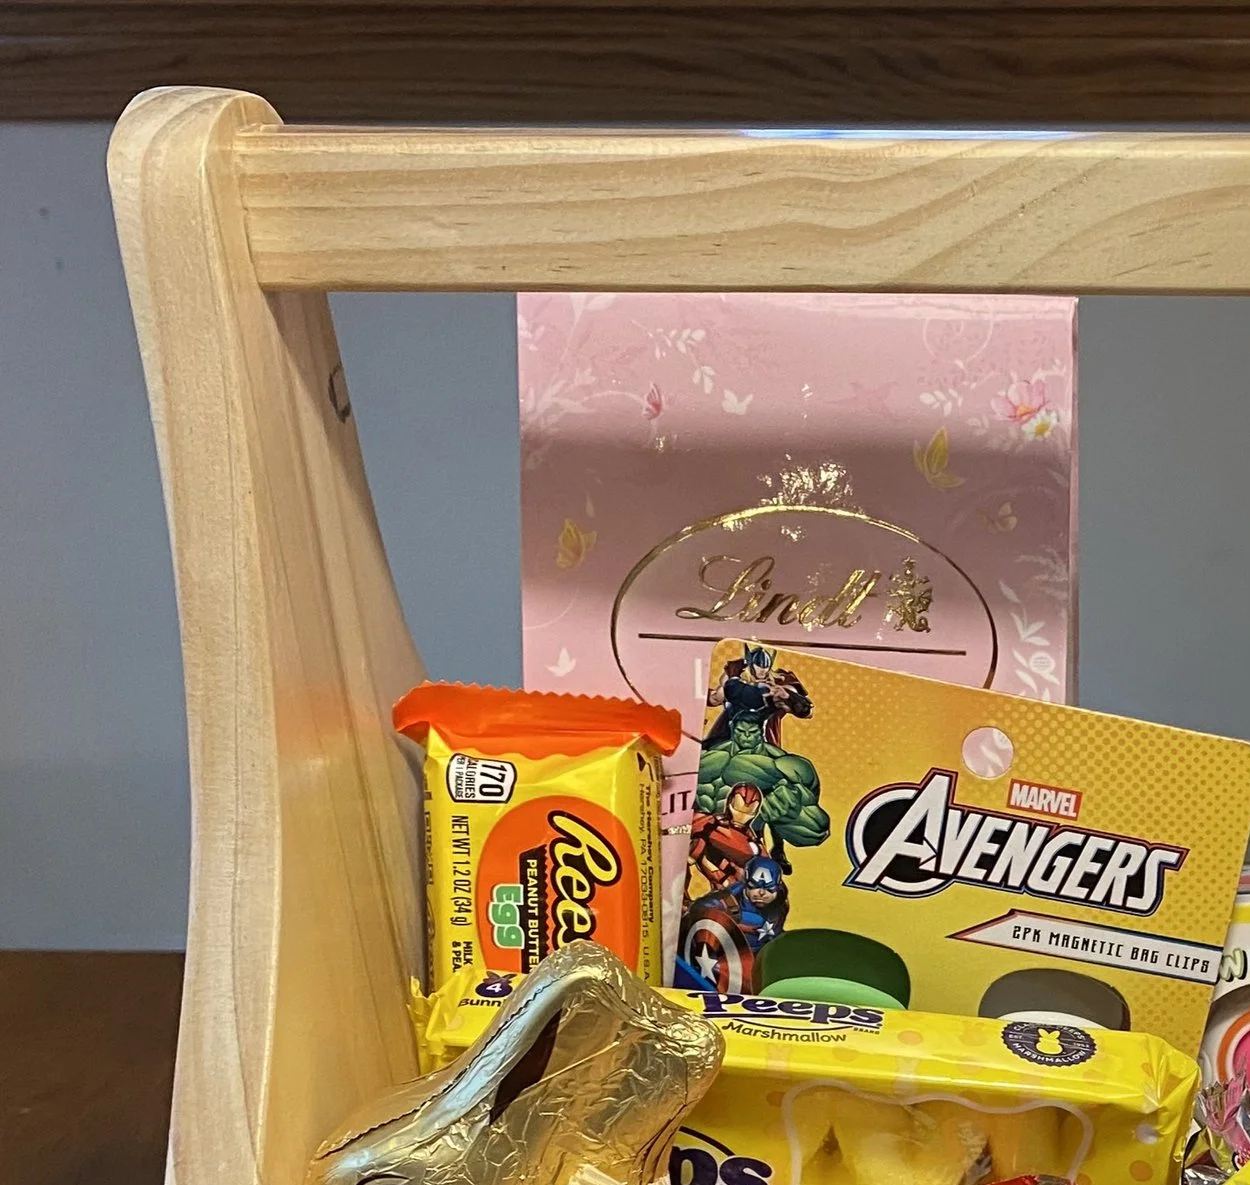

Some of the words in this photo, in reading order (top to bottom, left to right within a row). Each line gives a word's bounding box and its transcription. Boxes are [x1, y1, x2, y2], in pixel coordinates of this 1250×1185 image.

[676, 555, 880, 629] Lindt
[479, 764, 507, 797] 170
[1010, 783, 1079, 818] MARVEL
[452, 816, 469, 835] NET
[453, 839, 470, 855] WT
[640, 839, 647, 854] PA
[848, 771, 1186, 914] AVENGERS
[453, 860, 470, 875] 1.2
[454, 880, 470, 893] OZ
[526, 859, 539, 916] PEANUT
[452, 896, 471, 913] (34
[451, 917, 472, 926] g)
[488, 884, 524, 949] Egg
[463, 941, 473, 965] MILK
[1012, 925, 1041, 944] 2PK
[1049, 932, 1124, 959] MAGNETIC
[1130, 945, 1159, 964] BAG
[1166, 952, 1210, 973] CLIPS
[452, 950, 461, 973] PEA
[485, 982, 503, 993] 4
[458, 998, 502, 1008] Bunn
[687, 992, 885, 1027] Peeps
[722, 1021, 847, 1043] Marshmallow
